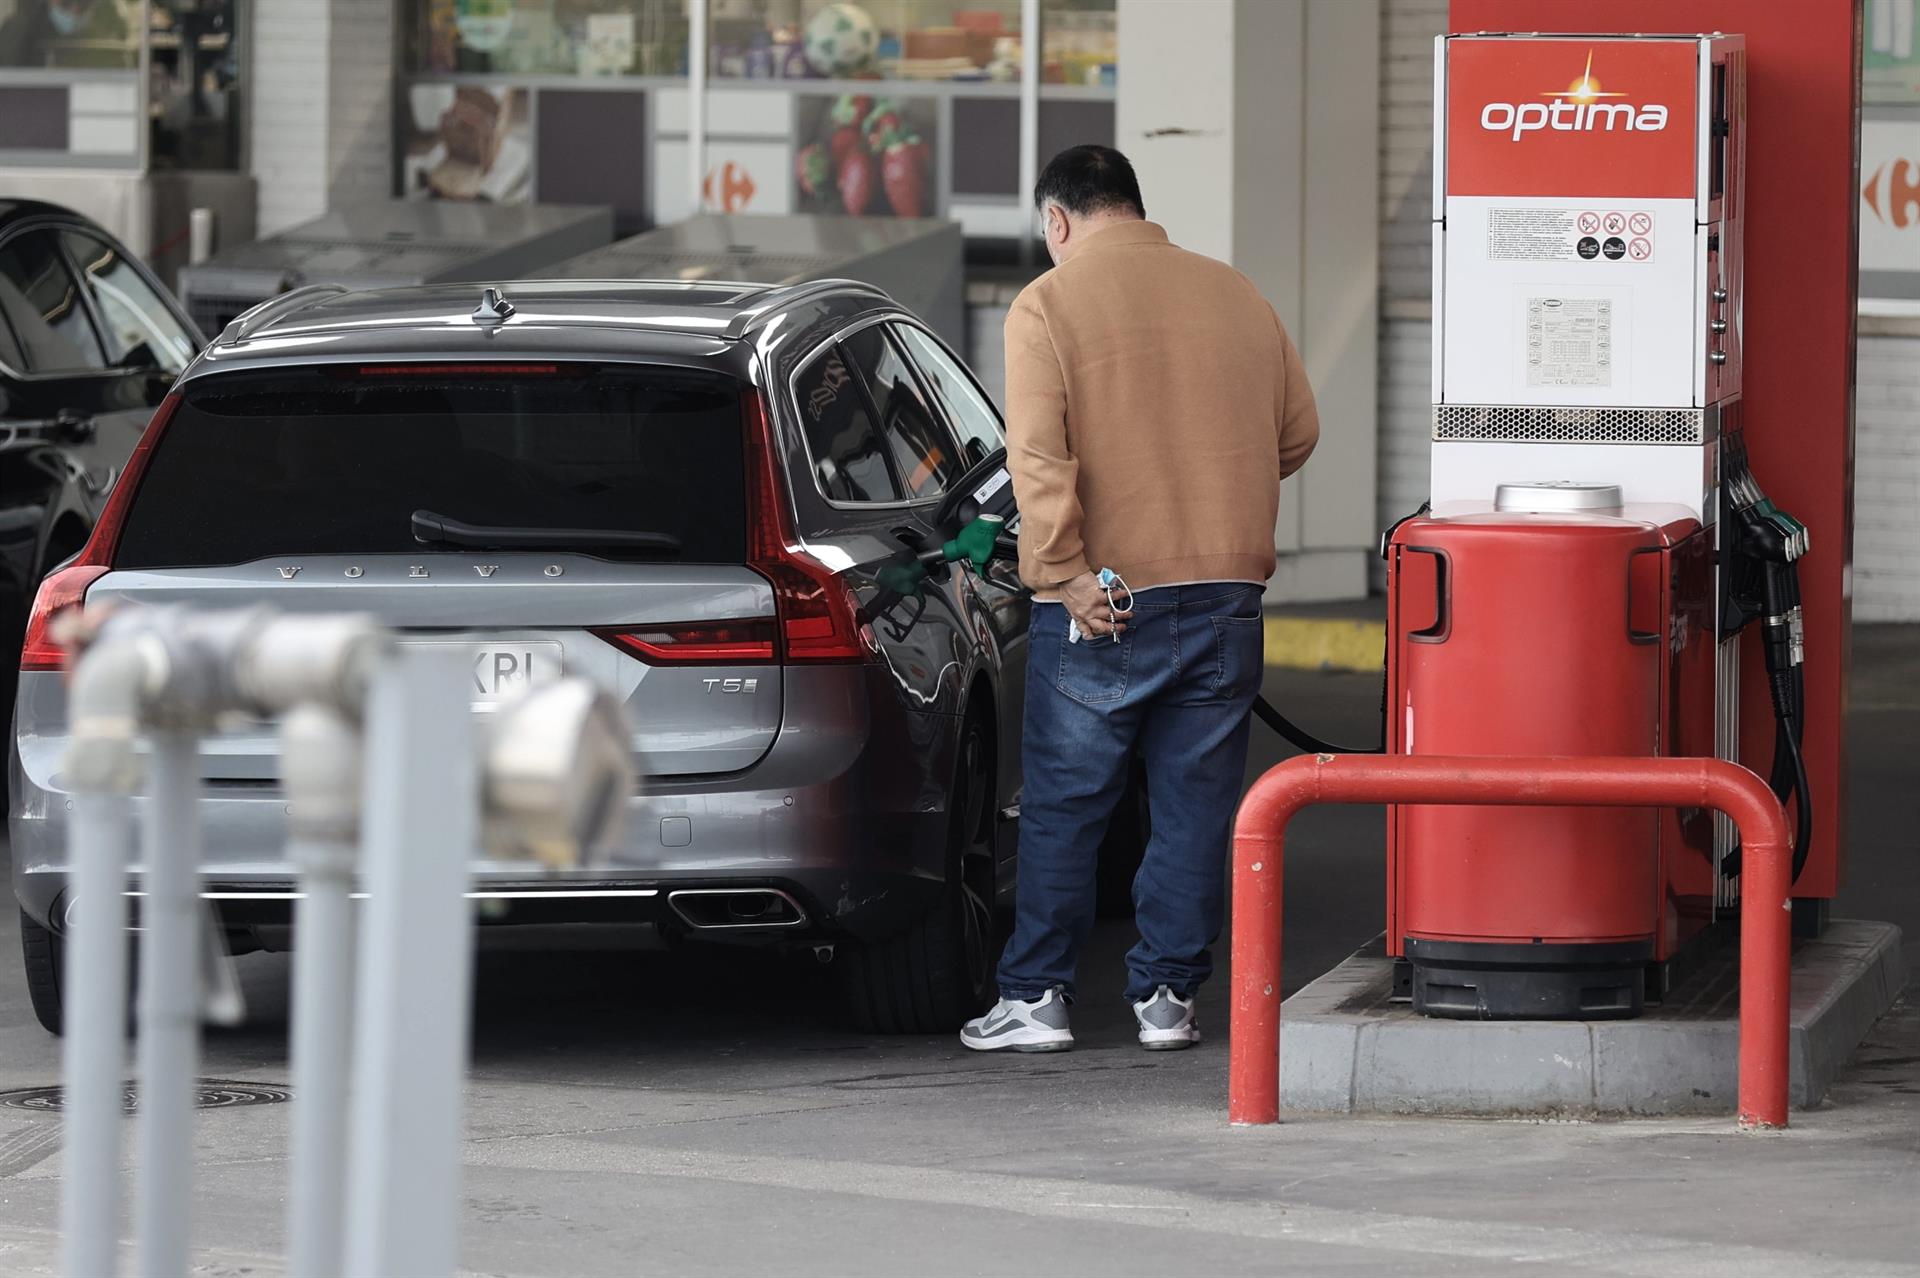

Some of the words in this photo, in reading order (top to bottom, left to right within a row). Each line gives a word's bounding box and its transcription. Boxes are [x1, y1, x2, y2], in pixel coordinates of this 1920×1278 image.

[1481, 99, 1668, 142] optima
[276, 565, 564, 579] VOLVO
[703, 678, 742, 693] T5
